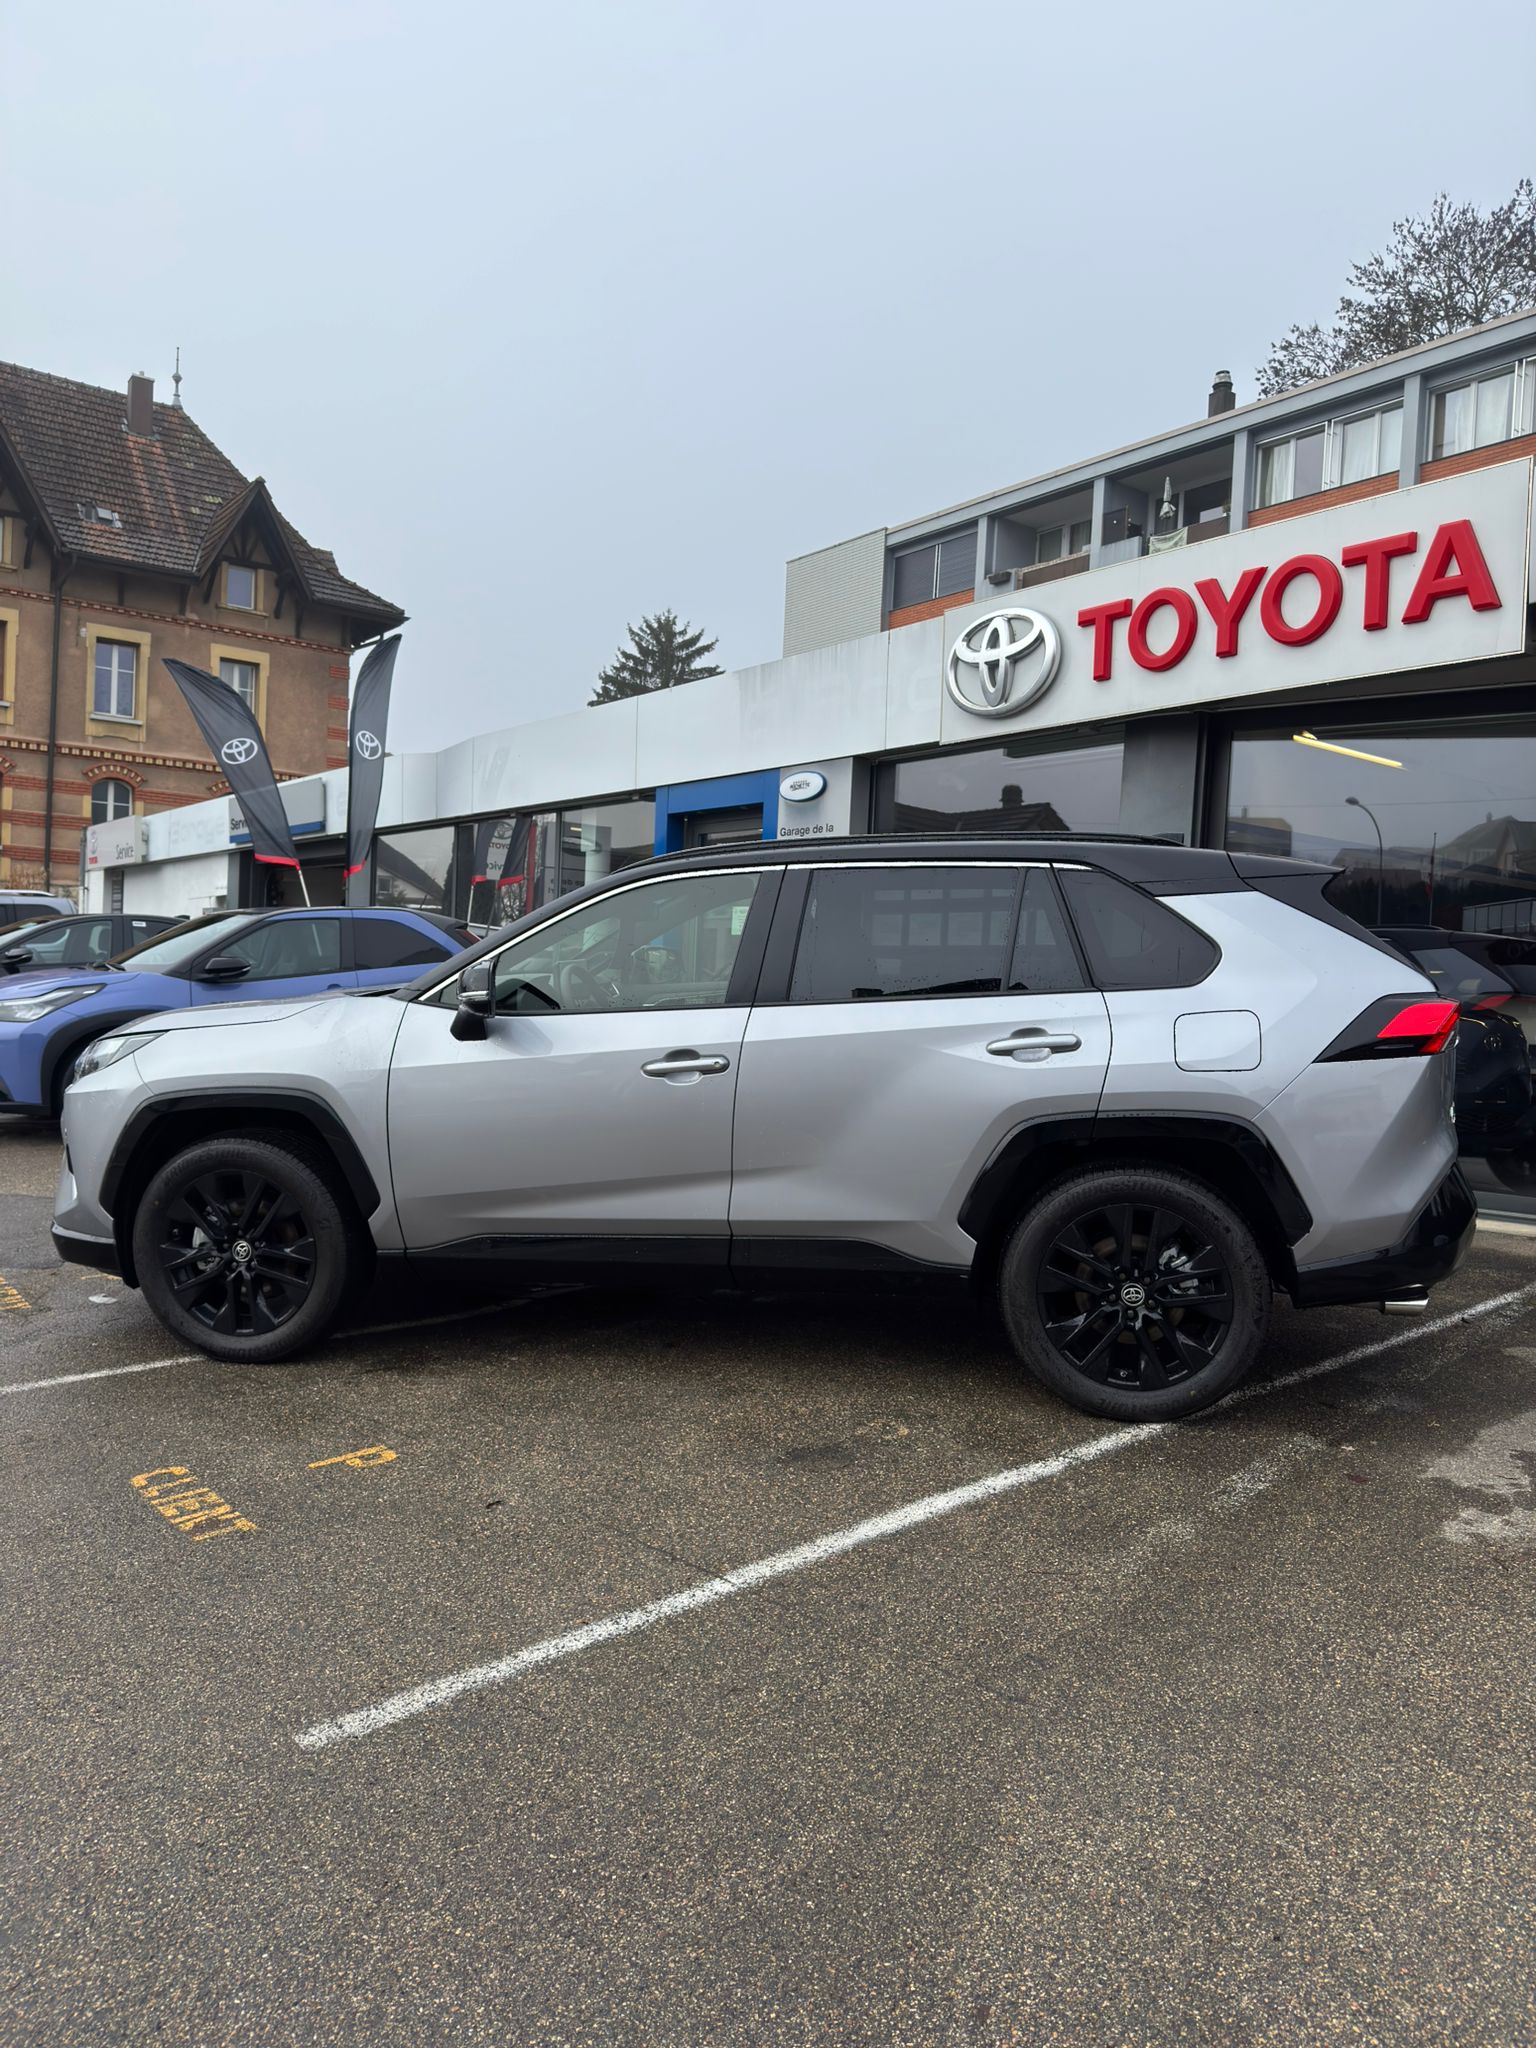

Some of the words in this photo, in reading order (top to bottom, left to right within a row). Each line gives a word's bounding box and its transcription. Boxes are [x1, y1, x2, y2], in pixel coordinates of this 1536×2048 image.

[1078, 519, 1502, 682] TOYOTA
[780, 826, 810, 837] Garage
[812, 824, 823, 834] de
[825, 823, 834, 833] la
[115, 842, 134, 860] Service
[308, 1445, 398, 1469] P
